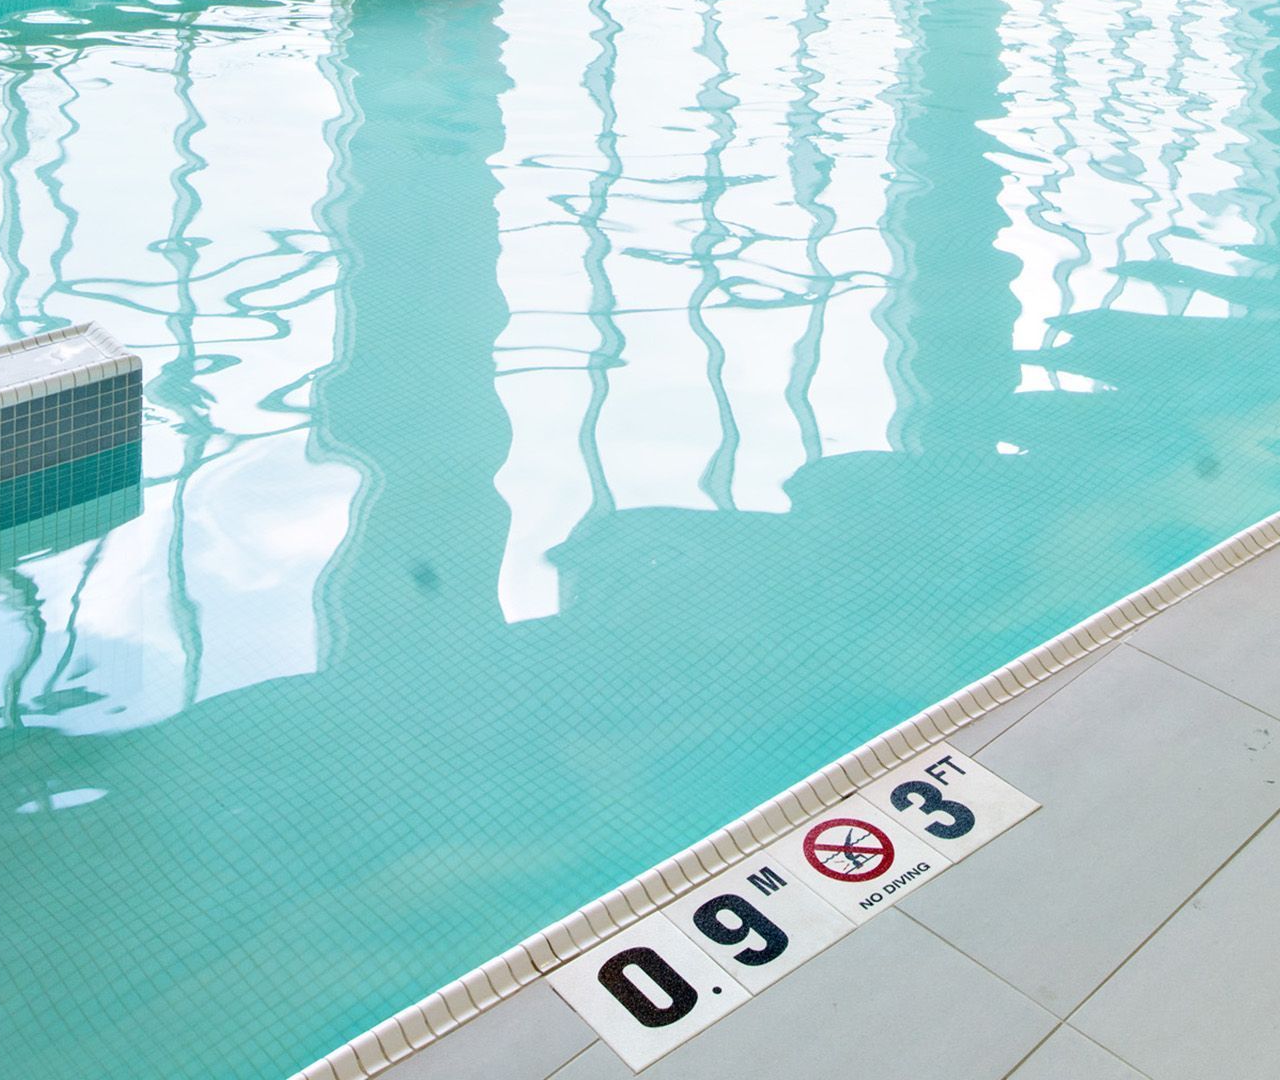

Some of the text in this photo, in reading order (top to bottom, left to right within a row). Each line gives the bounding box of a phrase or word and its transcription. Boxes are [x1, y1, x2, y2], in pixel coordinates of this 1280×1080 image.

[923, 755, 967, 786] FT
[890, 780, 976, 840] 3
[746, 866, 788, 897] M
[858, 861, 931, 910] NO DIVING
